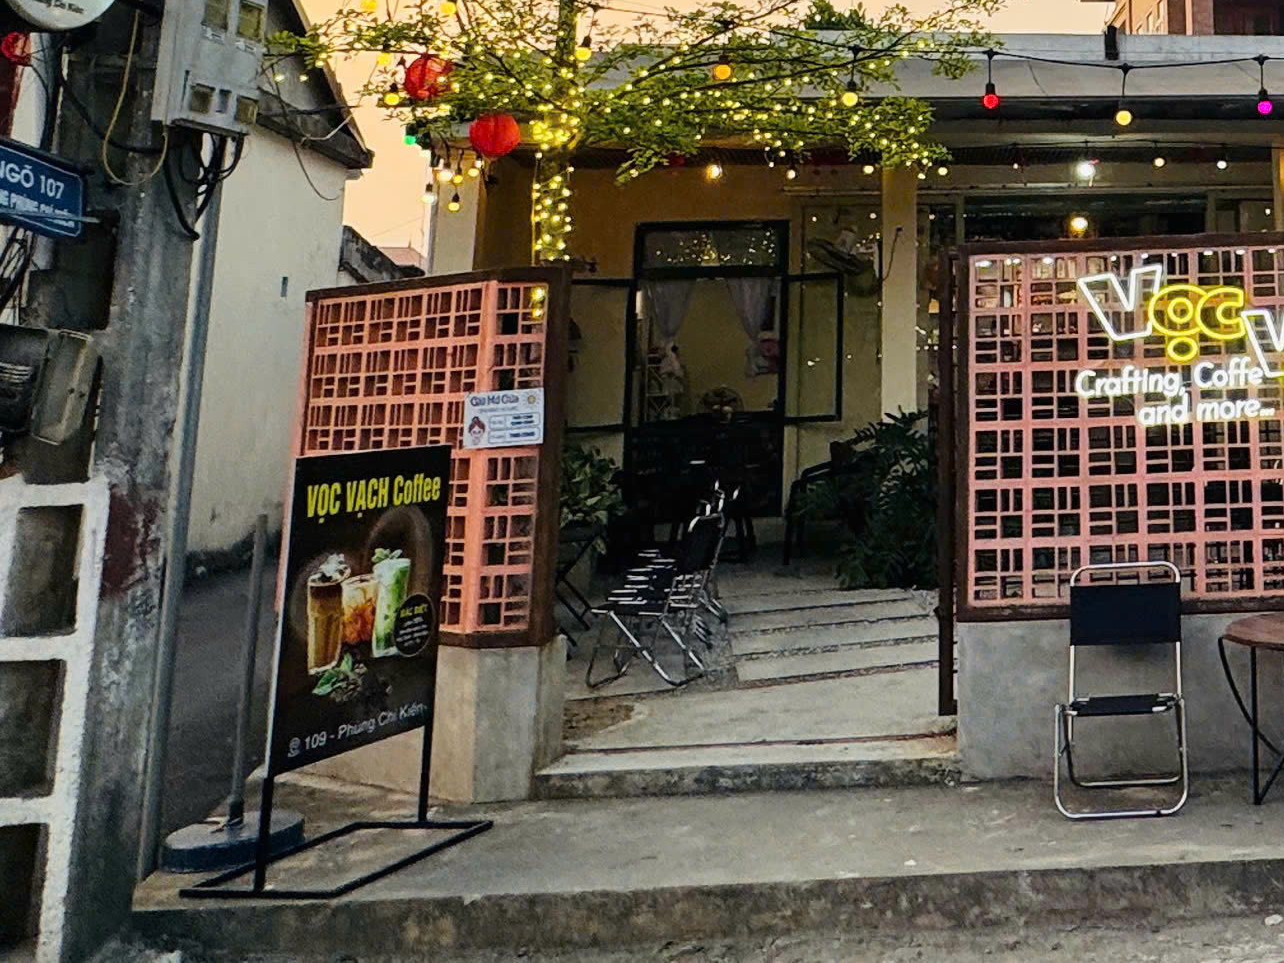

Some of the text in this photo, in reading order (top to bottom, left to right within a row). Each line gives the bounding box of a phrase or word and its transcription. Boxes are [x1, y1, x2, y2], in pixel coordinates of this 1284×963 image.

[40, 174, 65, 199] 107
[1138, 399, 1189, 427] and
[306, 472, 442, 524] VỌC VẠCH Coffee
[305, 731, 328, 750] 109
